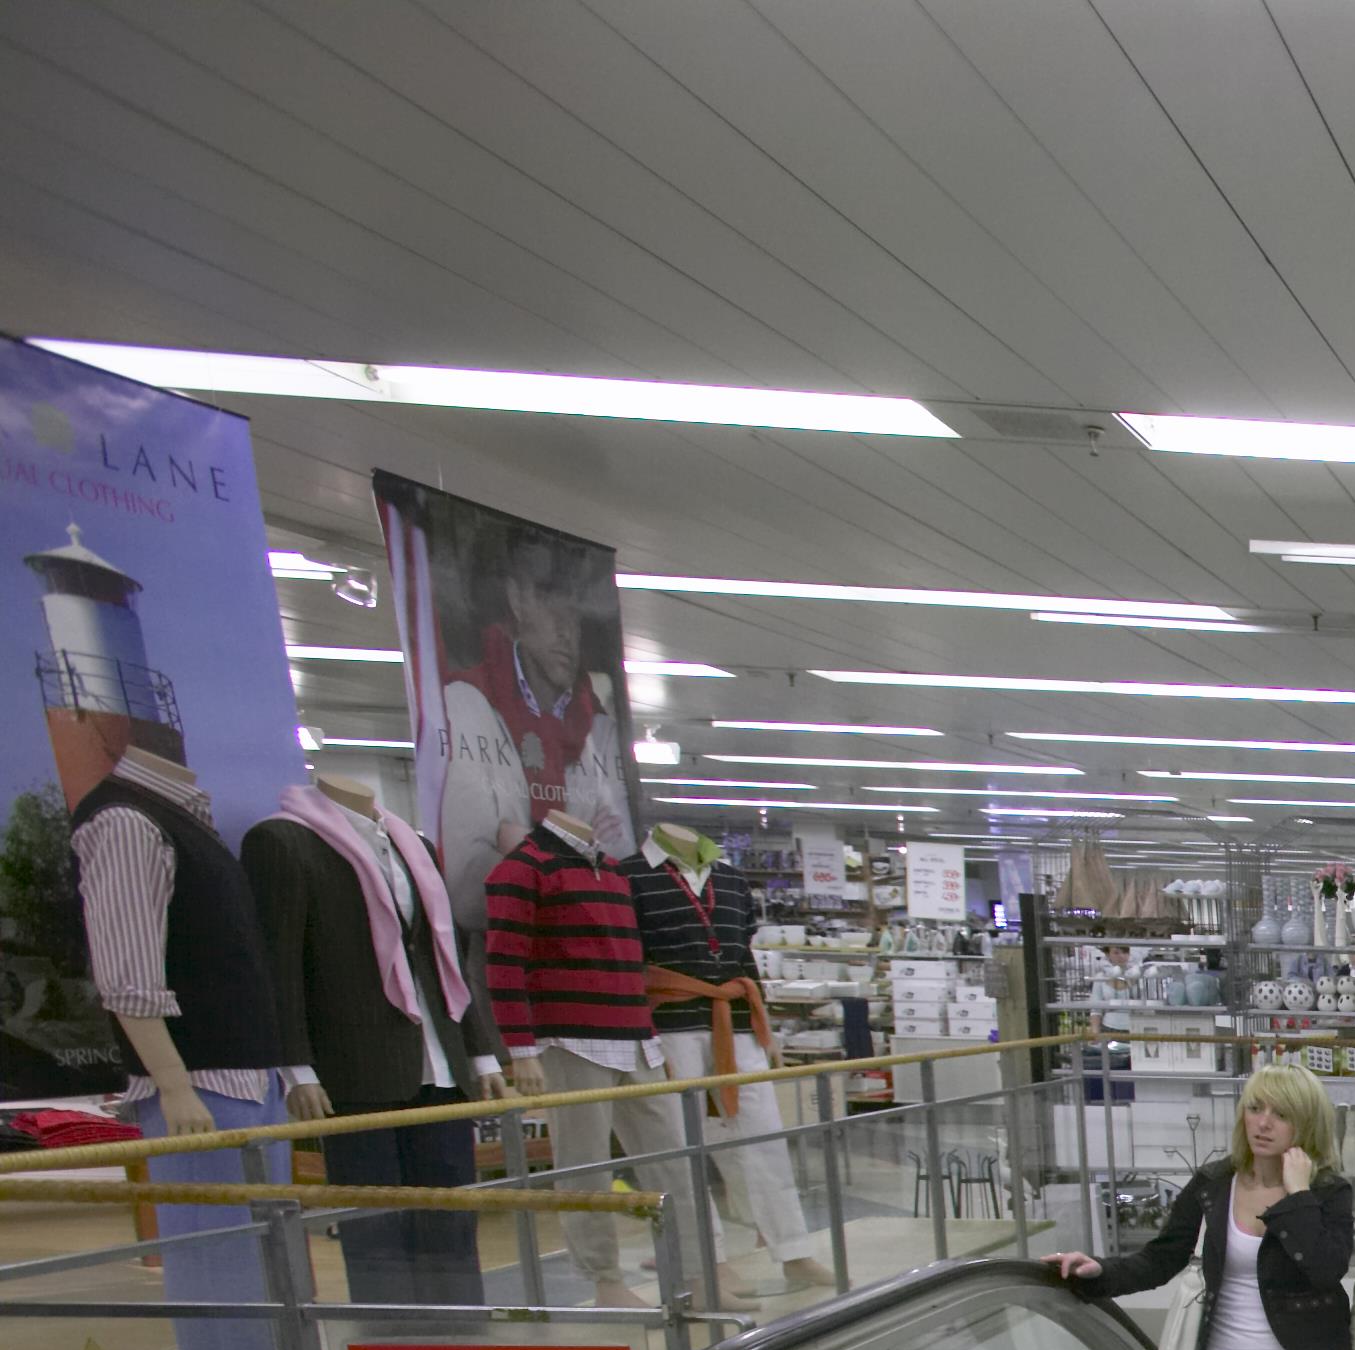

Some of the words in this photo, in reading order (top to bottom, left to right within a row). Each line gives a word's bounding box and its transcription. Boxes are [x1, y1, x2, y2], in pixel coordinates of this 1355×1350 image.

[101, 433, 230, 502] LANE
[49, 470, 175, 522] CLOTHING
[438, 728, 514, 767] PARK
